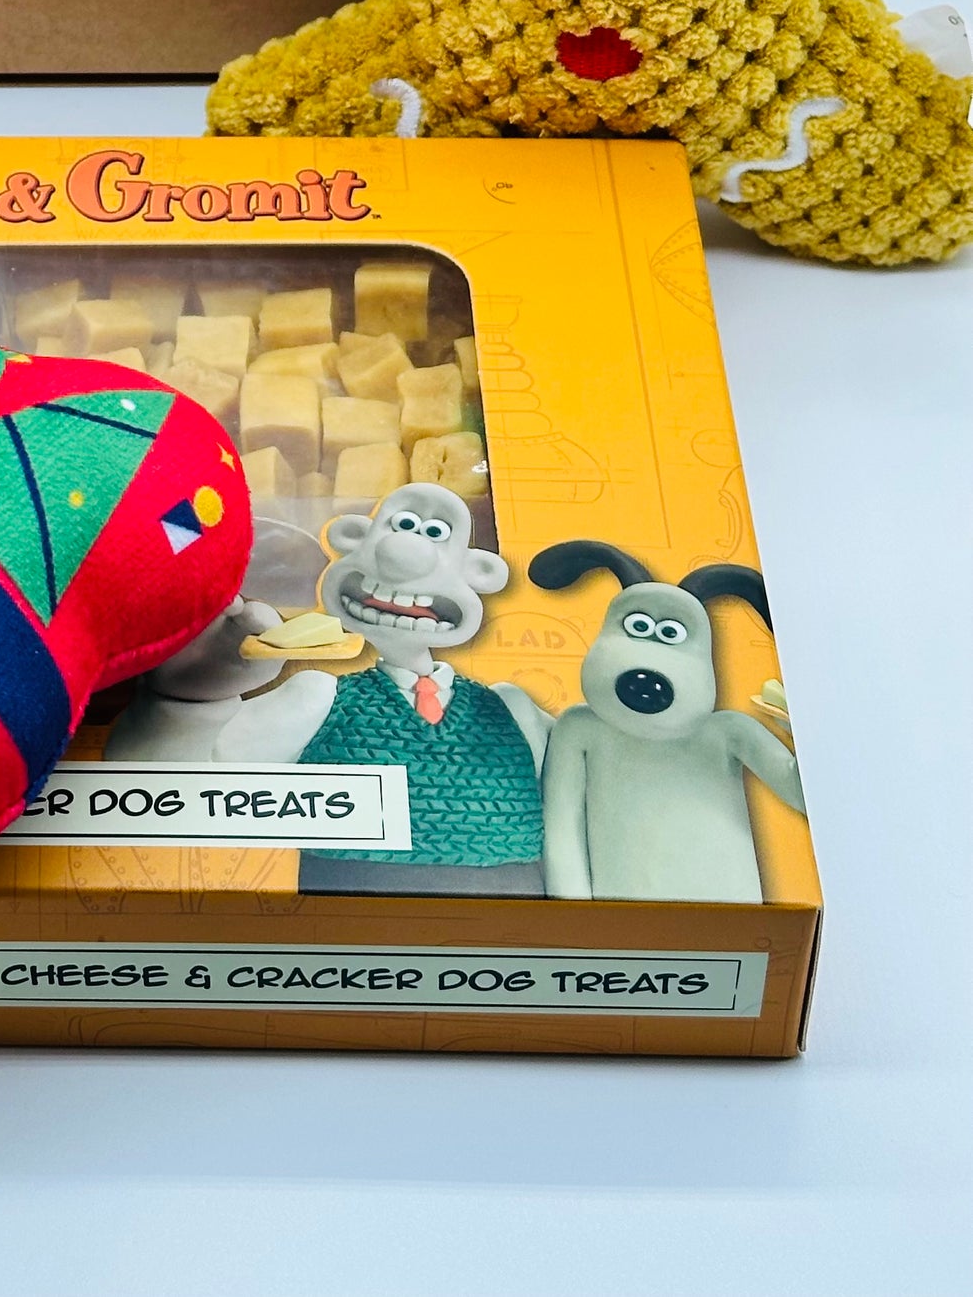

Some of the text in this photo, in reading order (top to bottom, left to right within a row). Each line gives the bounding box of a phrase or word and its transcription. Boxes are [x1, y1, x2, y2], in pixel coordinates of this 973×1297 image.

[66, 149, 373, 224] Gromit
[494, 628, 567, 650] LAD
[88, 788, 185, 818] DOG
[199, 790, 356, 820] TREATS
[0, 963, 710, 996] CHEESE & CRACKER DOG TREATS
